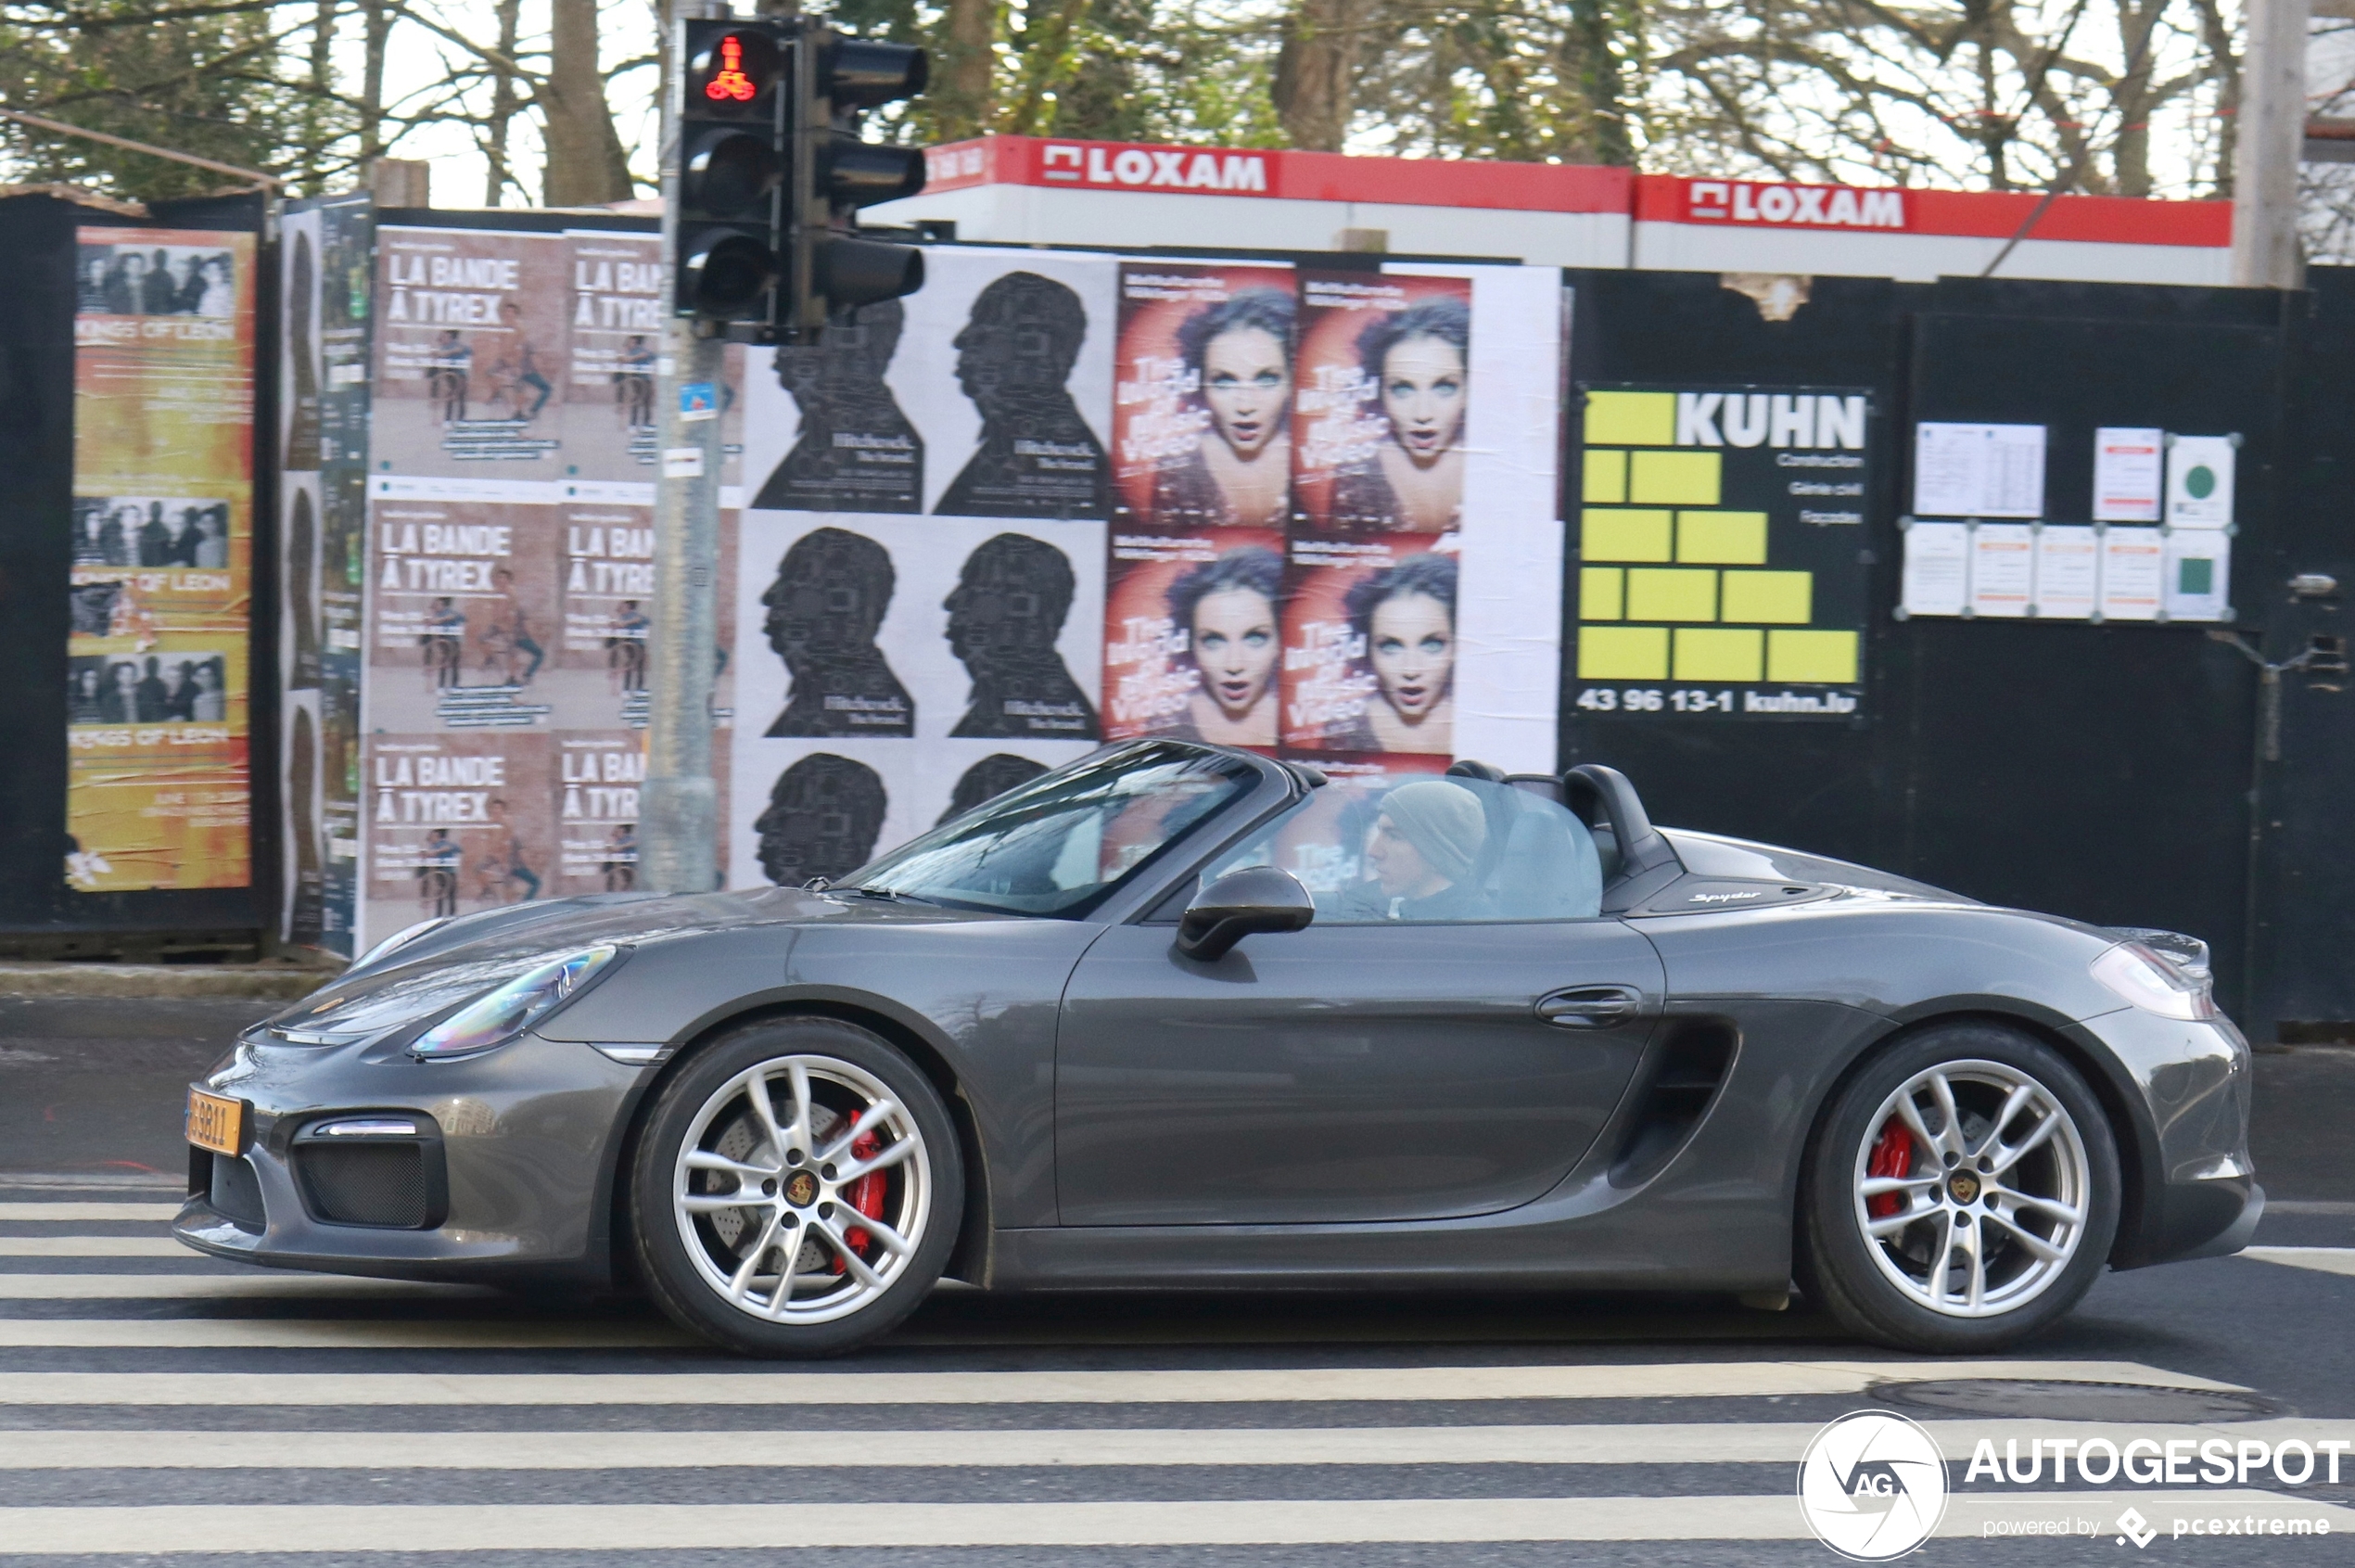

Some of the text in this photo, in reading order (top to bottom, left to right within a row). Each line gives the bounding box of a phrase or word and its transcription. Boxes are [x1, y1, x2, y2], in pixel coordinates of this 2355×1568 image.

[1088, 148, 1267, 191] LOXAM
[1733, 185, 1905, 228] LOXAM
[389, 255, 519, 290] LA BANDE
[575, 260, 612, 290] LA
[413, 292, 503, 324] TYREX
[1676, 393, 1865, 449] KUHN
[381, 524, 512, 556] LA BANDE
[568, 526, 605, 556] LA
[405, 559, 494, 591] TYREX
[1577, 688, 1856, 713] 43 96 13-1 kuhn.lu
[376, 757, 505, 786] LA BANDE
[562, 752, 599, 782] LA
[400, 792, 490, 822] TYREX
[1688, 892, 1762, 902] Spyder
